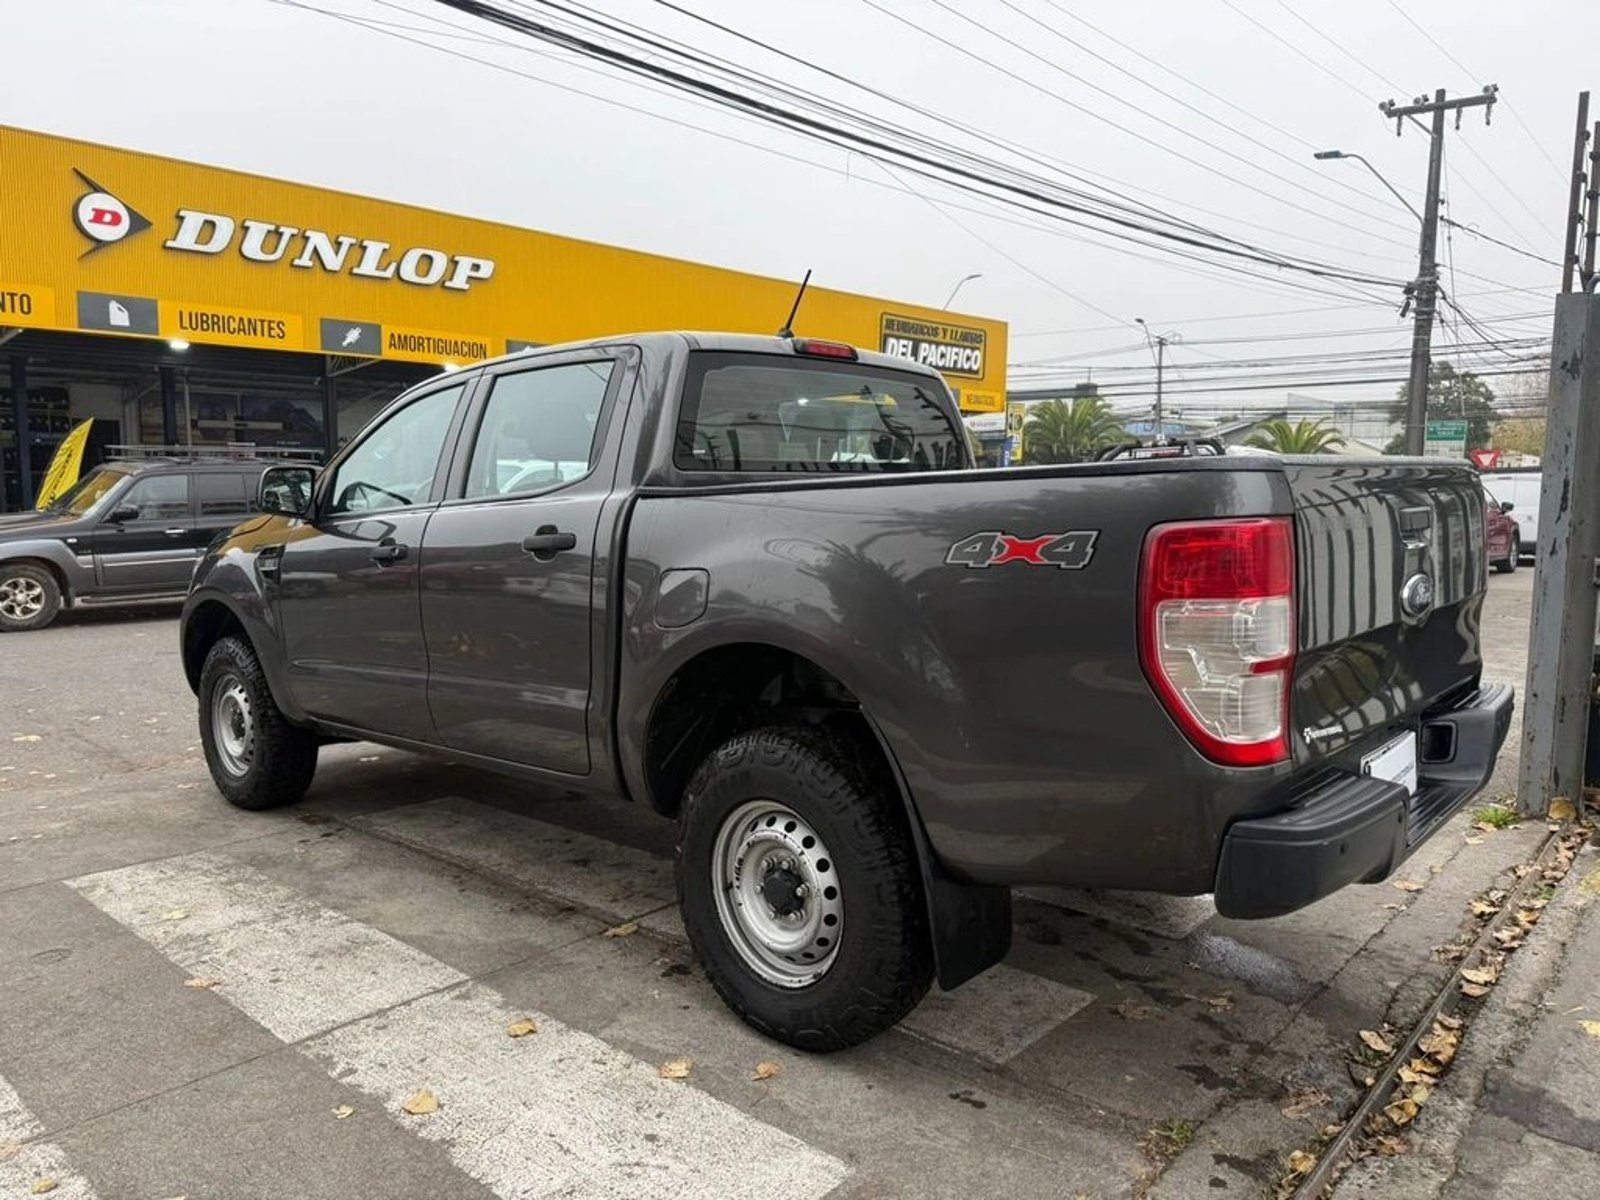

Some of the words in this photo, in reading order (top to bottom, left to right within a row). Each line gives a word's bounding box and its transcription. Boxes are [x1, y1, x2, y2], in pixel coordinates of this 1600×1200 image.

[164, 208, 496, 291] DUNLOP
[178, 309, 286, 340] LUBRICANTES
[388, 332, 488, 360] AMORTIGUACION
[885, 336, 915, 361] DEL
[918, 341, 982, 371] PACIFICO
